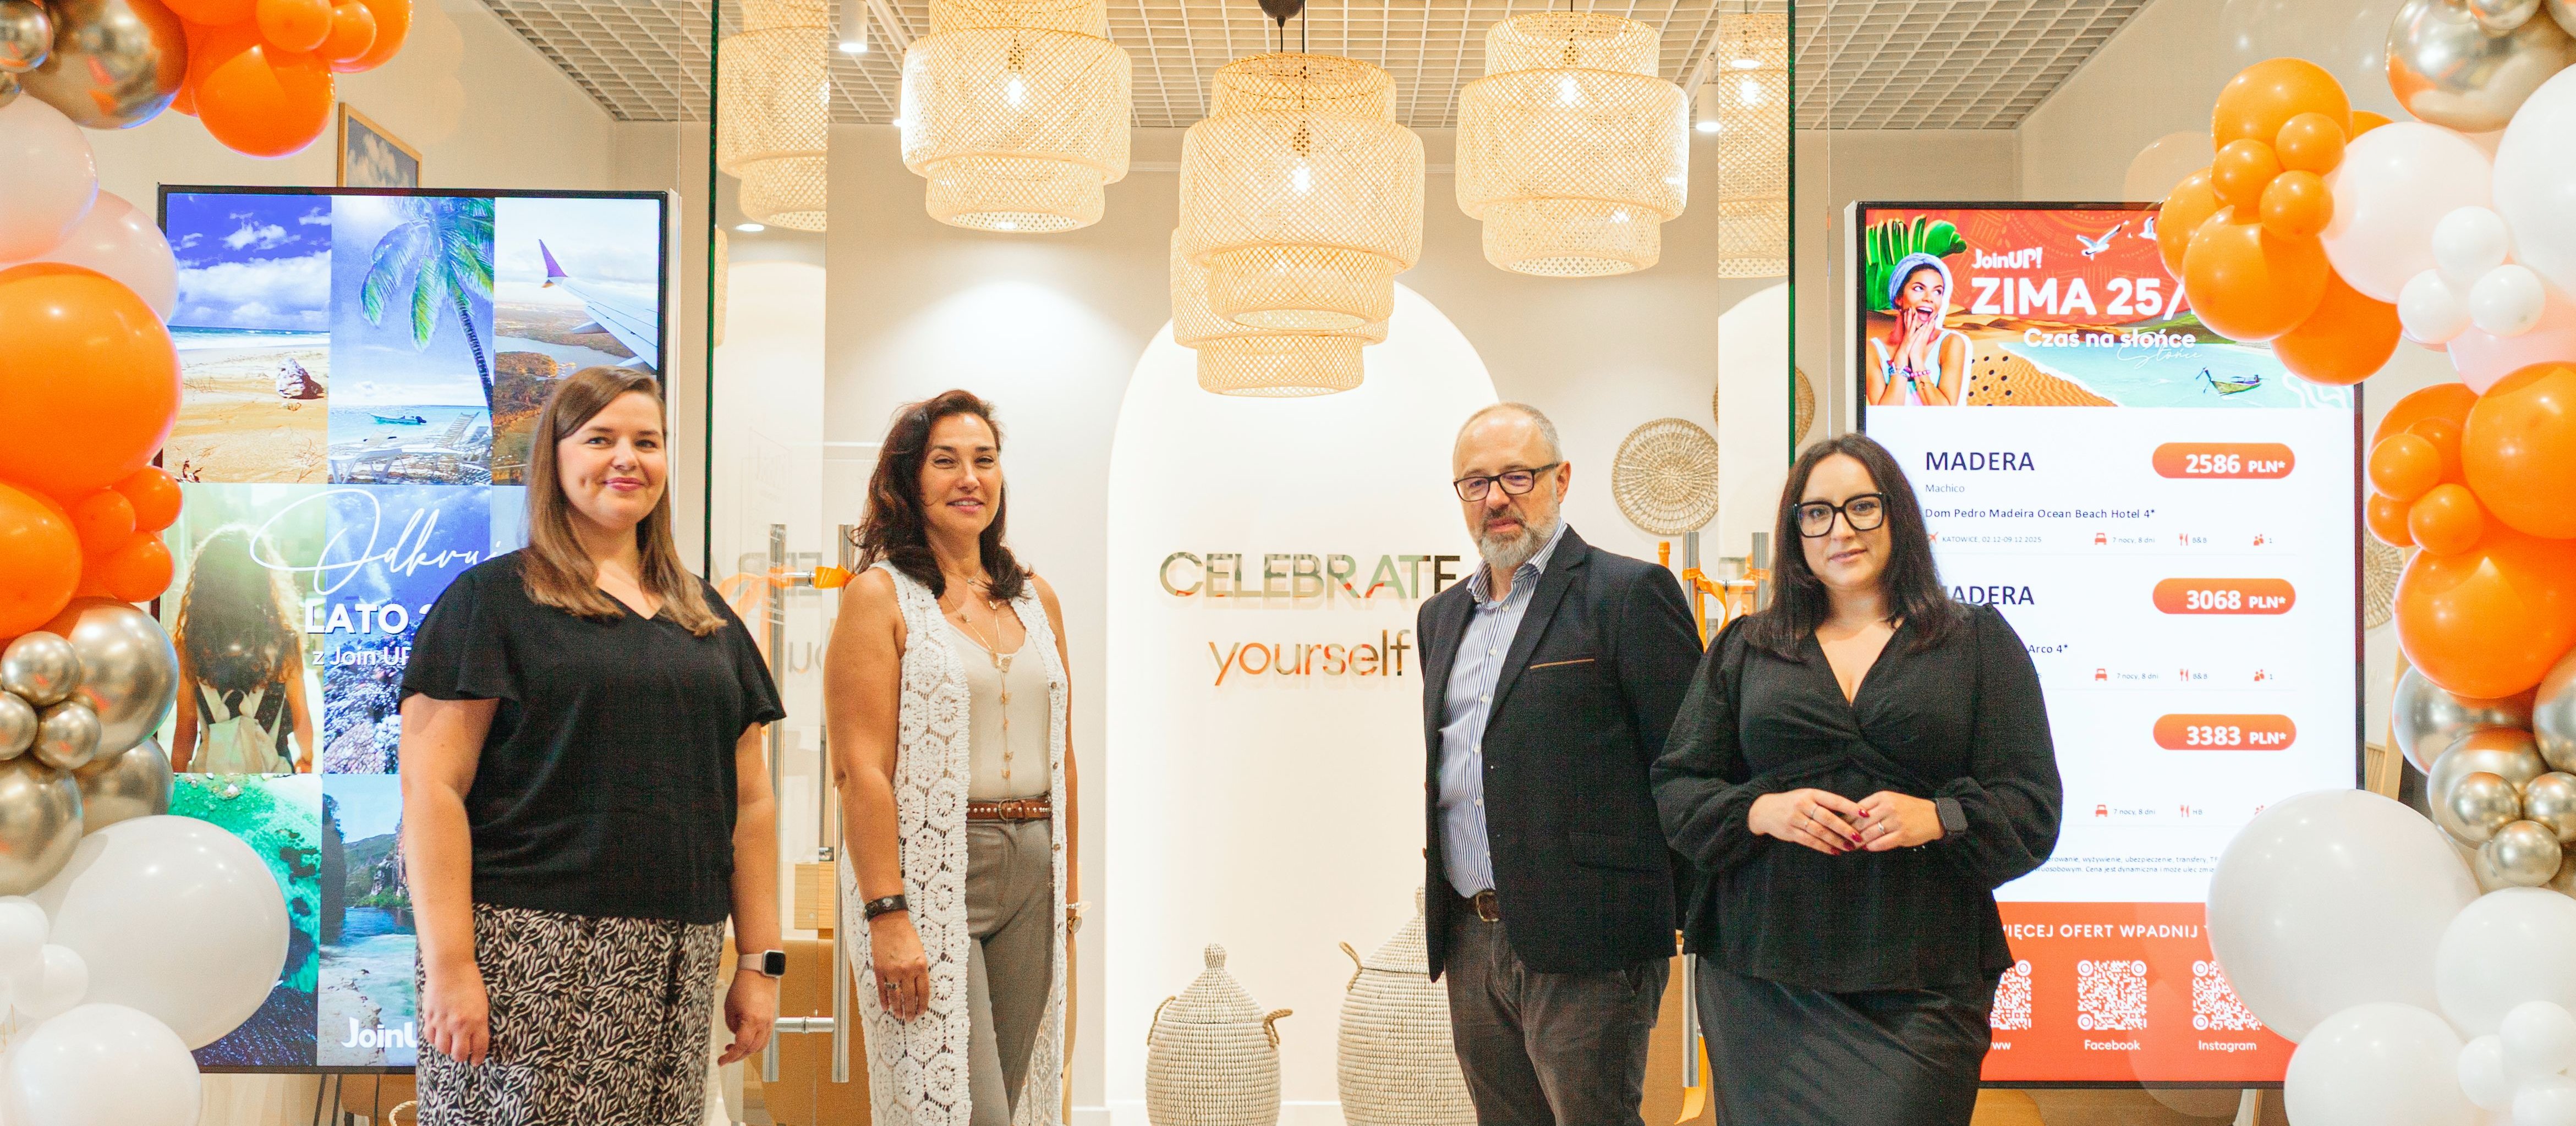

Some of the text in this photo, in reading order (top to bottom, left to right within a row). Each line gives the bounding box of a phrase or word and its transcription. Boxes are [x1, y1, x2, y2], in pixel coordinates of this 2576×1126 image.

[1971, 246, 2043, 269] JoinUP!
[1971, 277, 2097, 315] ZIMA
[2023, 328, 2196, 348] Czas na słońce
[1926, 452, 2035, 471] MADERA
[2185, 454, 2241, 474] 2586
[1926, 484, 1965, 493] Machico
[1926, 509, 1950, 518] Dom
[1954, 509, 1986, 518] Pedro
[1989, 509, 2034, 518] Madeira
[2037, 509, 2071, 518] Ocean
[2075, 509, 2107, 518] Beach
[2111, 509, 2140, 518] Hotel
[1948, 586, 2035, 605] ADERA
[2186, 590, 2241, 609] 3068
[305, 603, 409, 634] LATO
[312, 651, 325, 665] z
[330, 646, 376, 666] Join
[1208, 629, 1411, 686] yourself
[2029, 645, 2053, 653] Arco
[2186, 726, 2241, 745] 3383
[2060, 924, 2113, 938] OFERT
[2119, 925, 2197, 938] WPADNIJ
[2084, 1039, 2141, 1051] Facebook
[2199, 1040, 2257, 1053] Instagram
